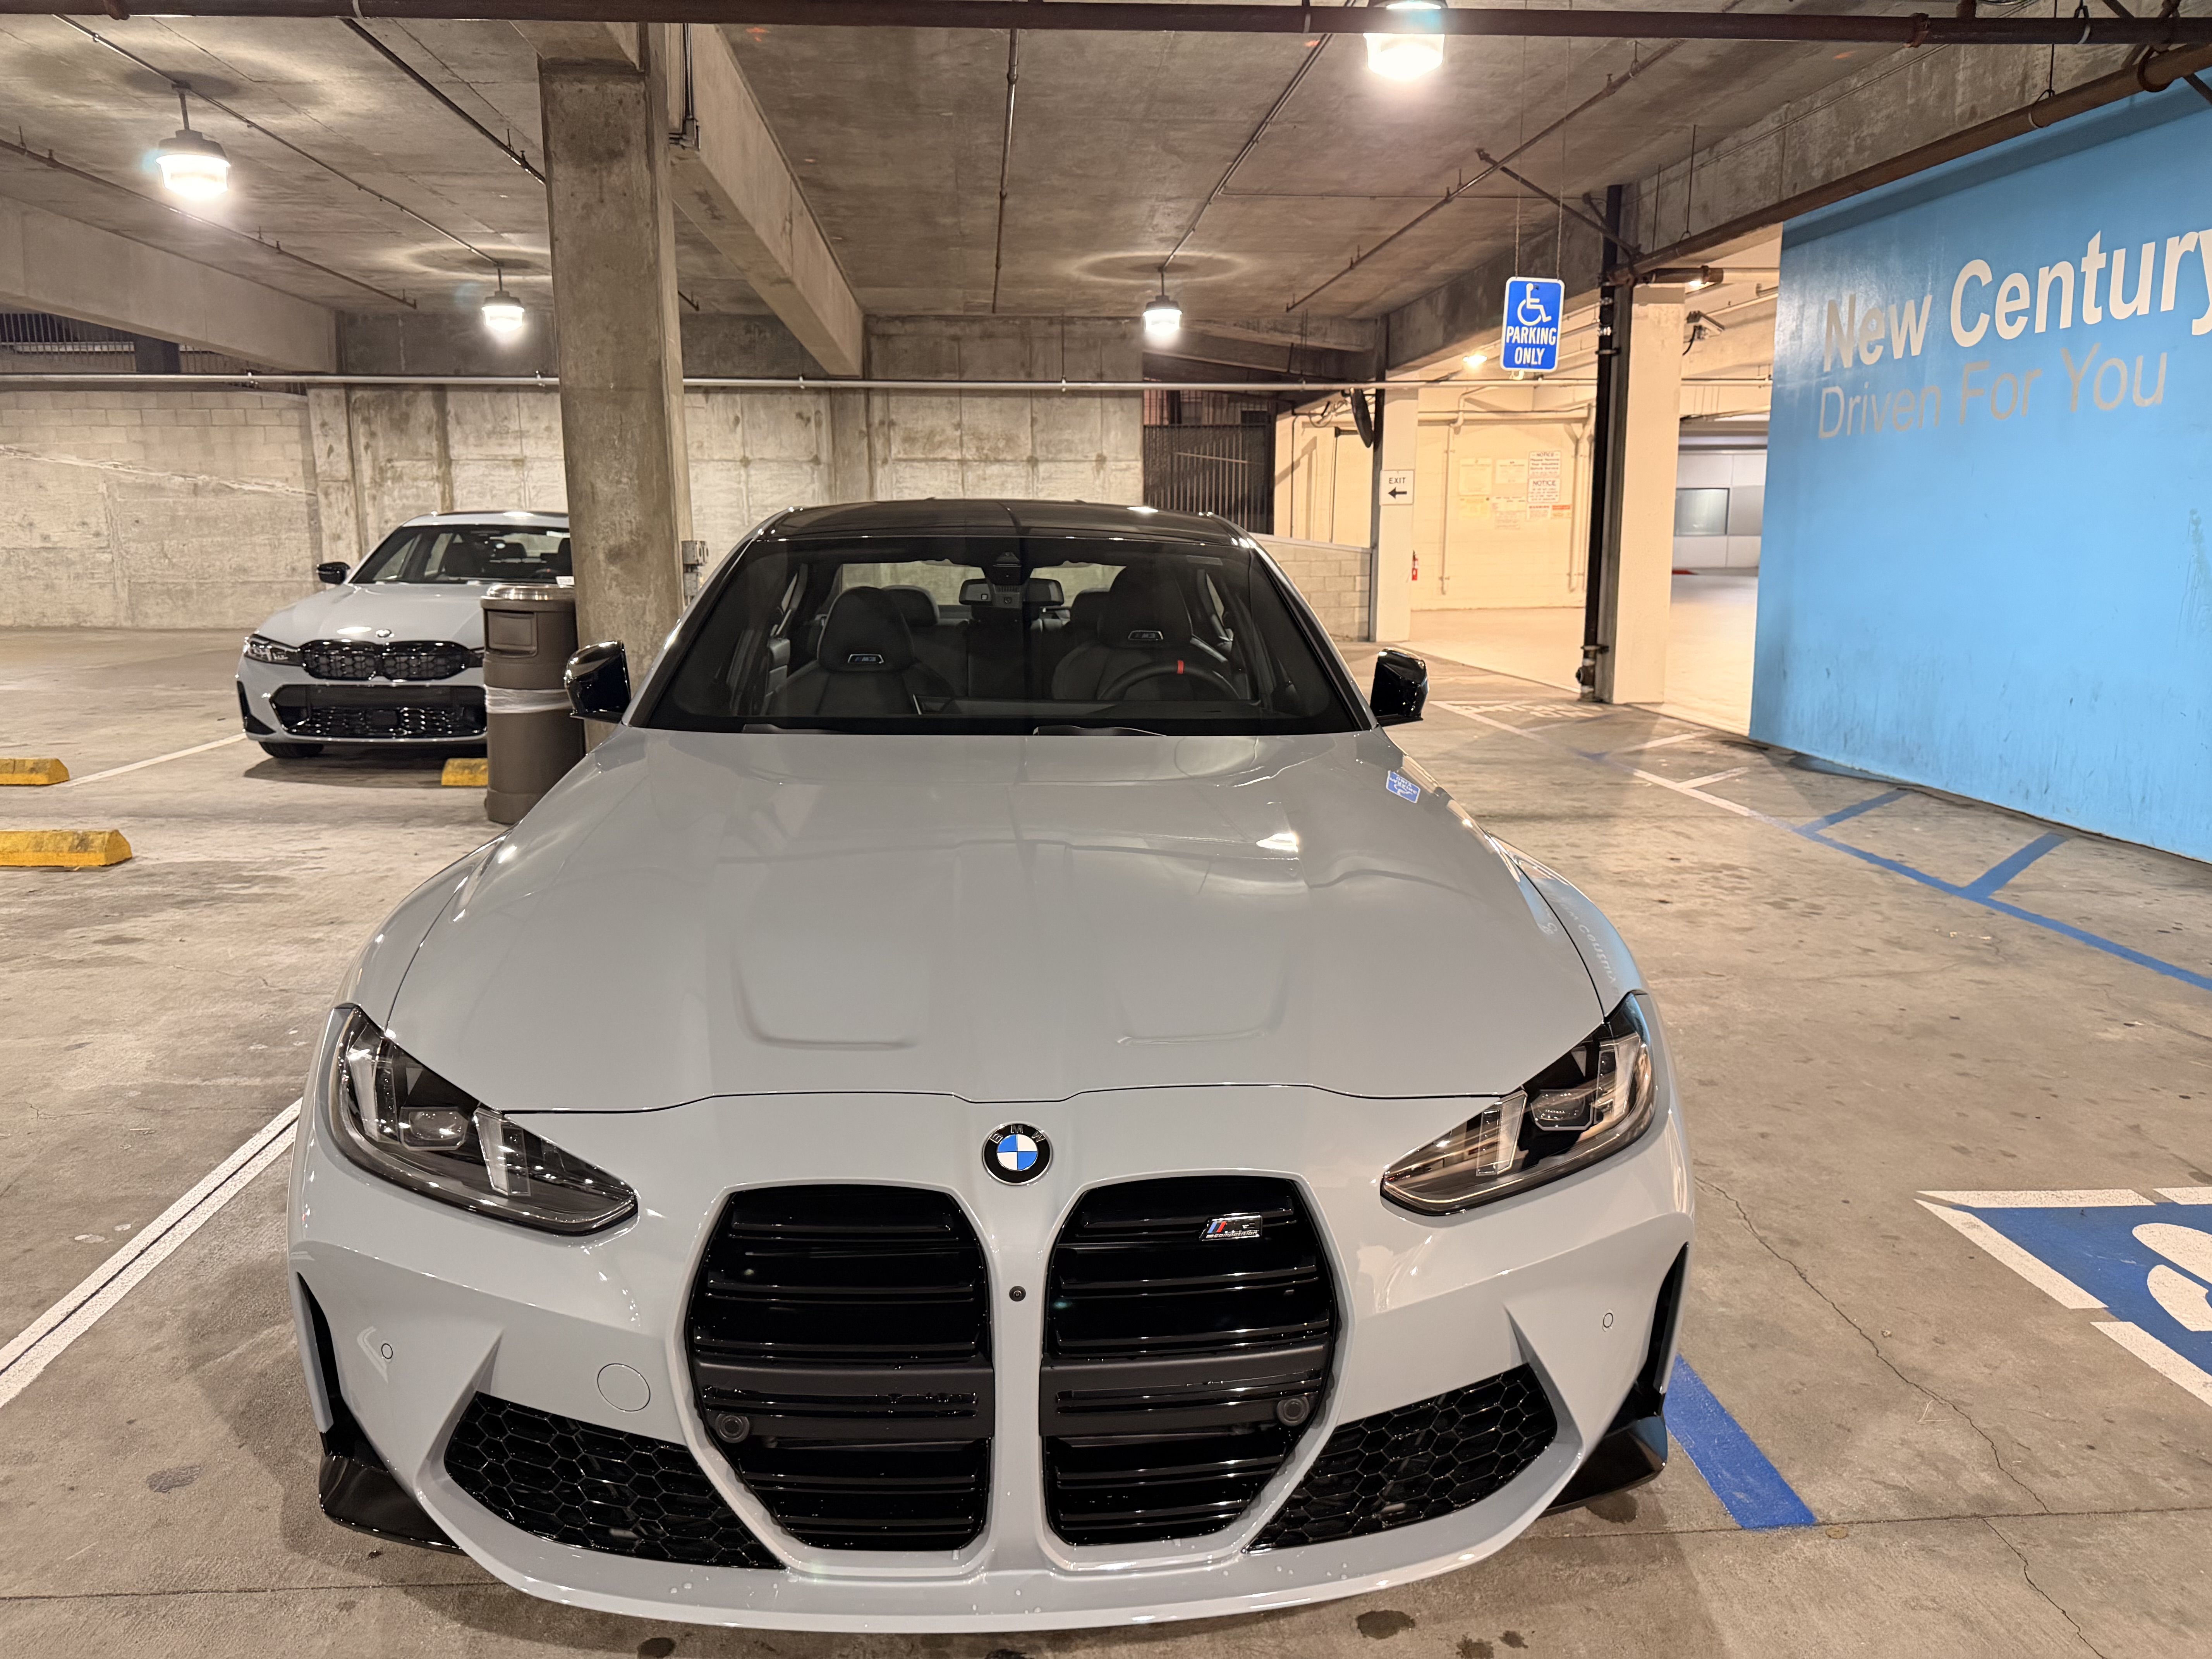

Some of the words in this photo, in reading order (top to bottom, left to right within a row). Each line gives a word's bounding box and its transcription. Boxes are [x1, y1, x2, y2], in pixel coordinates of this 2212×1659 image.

[1823, 294, 1932, 372] New
[1950, 229, 2212, 347] Century
[1506, 326, 1557, 345] PARKING
[1515, 347, 1545, 365] ONLY
[1818, 382, 1941, 439] Driven
[1959, 360, 2042, 425] For
[2061, 342, 2167, 412] You
[989, 1125, 1046, 1144] BMW
